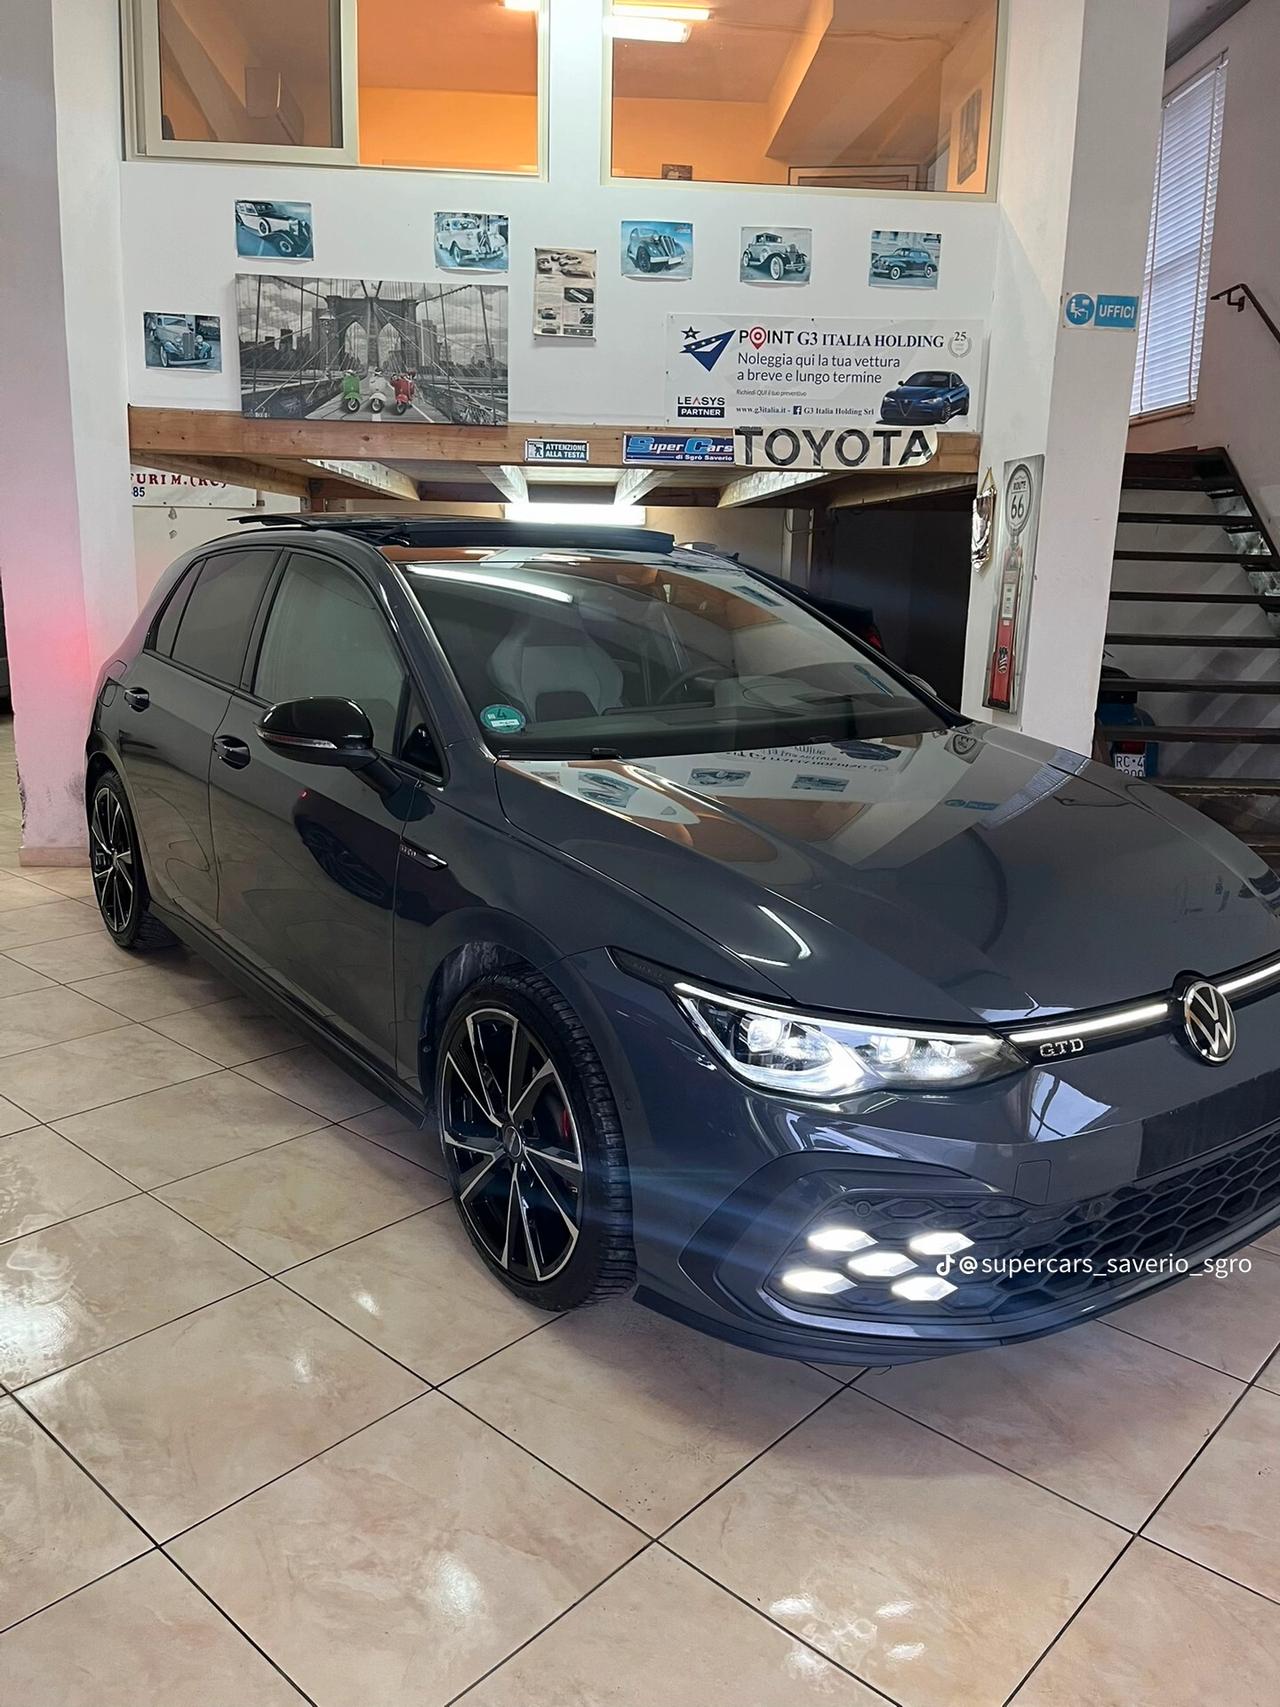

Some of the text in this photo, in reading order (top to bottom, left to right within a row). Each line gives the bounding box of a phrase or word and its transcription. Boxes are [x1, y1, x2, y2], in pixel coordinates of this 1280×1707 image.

[1099, 304, 1135, 320] UFFICI
[739, 326, 795, 350] POINT
[797, 331, 818, 346] G3
[822, 333, 871, 348] ITALIA
[875, 335, 945, 349] HOLDING
[954, 331, 967, 342] 25
[737, 352, 900, 370] Noleggia qui la tua vettura
[736, 368, 882, 385] a breve e lungo termine
[677, 396, 726, 406] LEASYS
[680, 408, 721, 417] PARTNER
[736, 406, 787, 415] www.g3italia.it
[835, 408, 862, 416] Holding
[864, 408, 875, 416] Srl
[545, 443, 586, 452] ATTENZIONE
[735, 427, 933, 467] TOYOTA
[545, 451, 586, 460] ALLA TESTA
[1013, 480, 1026, 490] ROUTE
[1011, 494, 1024, 519] 66
[1039, 1037, 1085, 1058] GTD
